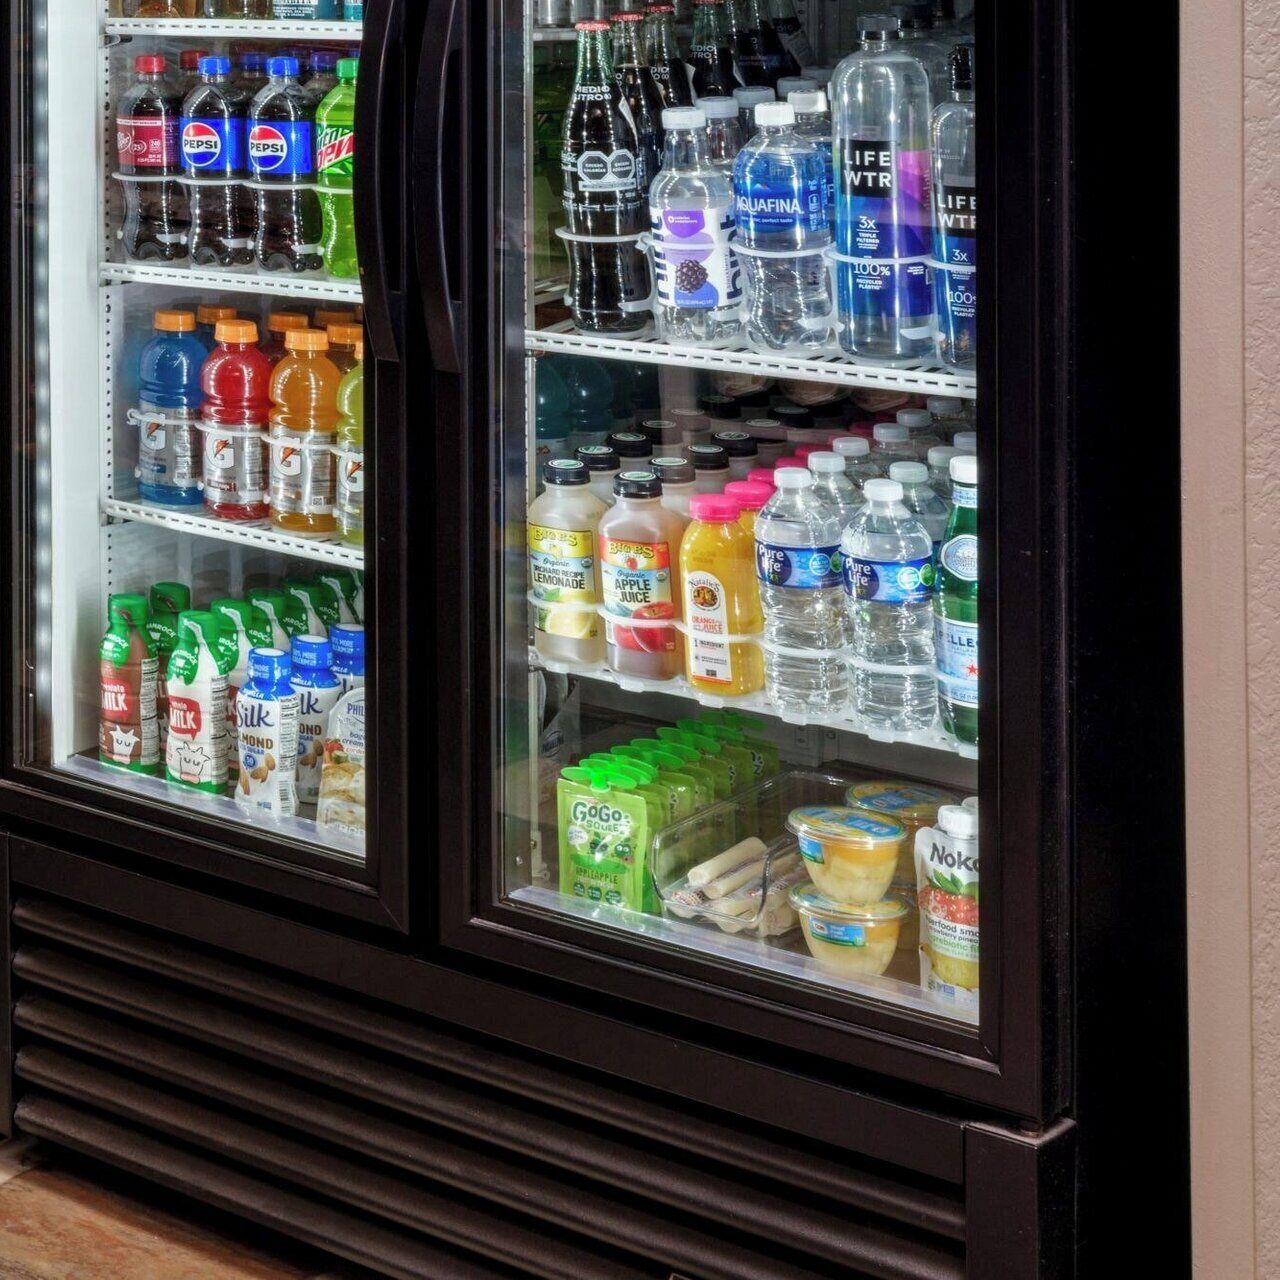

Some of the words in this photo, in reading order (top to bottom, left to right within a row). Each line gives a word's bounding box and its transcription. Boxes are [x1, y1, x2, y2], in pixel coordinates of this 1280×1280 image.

[575, 85, 610, 94] MEDIO
[184, 140, 218, 151] PEPSI
[250, 141, 285, 153] PEPSI
[844, 150, 891, 167] LIFE
[845, 170, 892, 188] WTR
[937, 194, 976, 211] LIFE
[858, 231, 877, 239] TRIPLE
[853, 262, 890, 277] 100%
[856, 278, 882, 286] RECYCLED
[759, 544, 784, 563] Pure
[761, 556, 782, 573] Life
[845, 557, 870, 576] Pure
[534, 572, 585, 590] LEMONADE
[561, 570, 585, 578] RECIPE
[848, 570, 870, 588] Life
[615, 578, 652, 591] APPLE
[620, 591, 651, 604] JUICE
